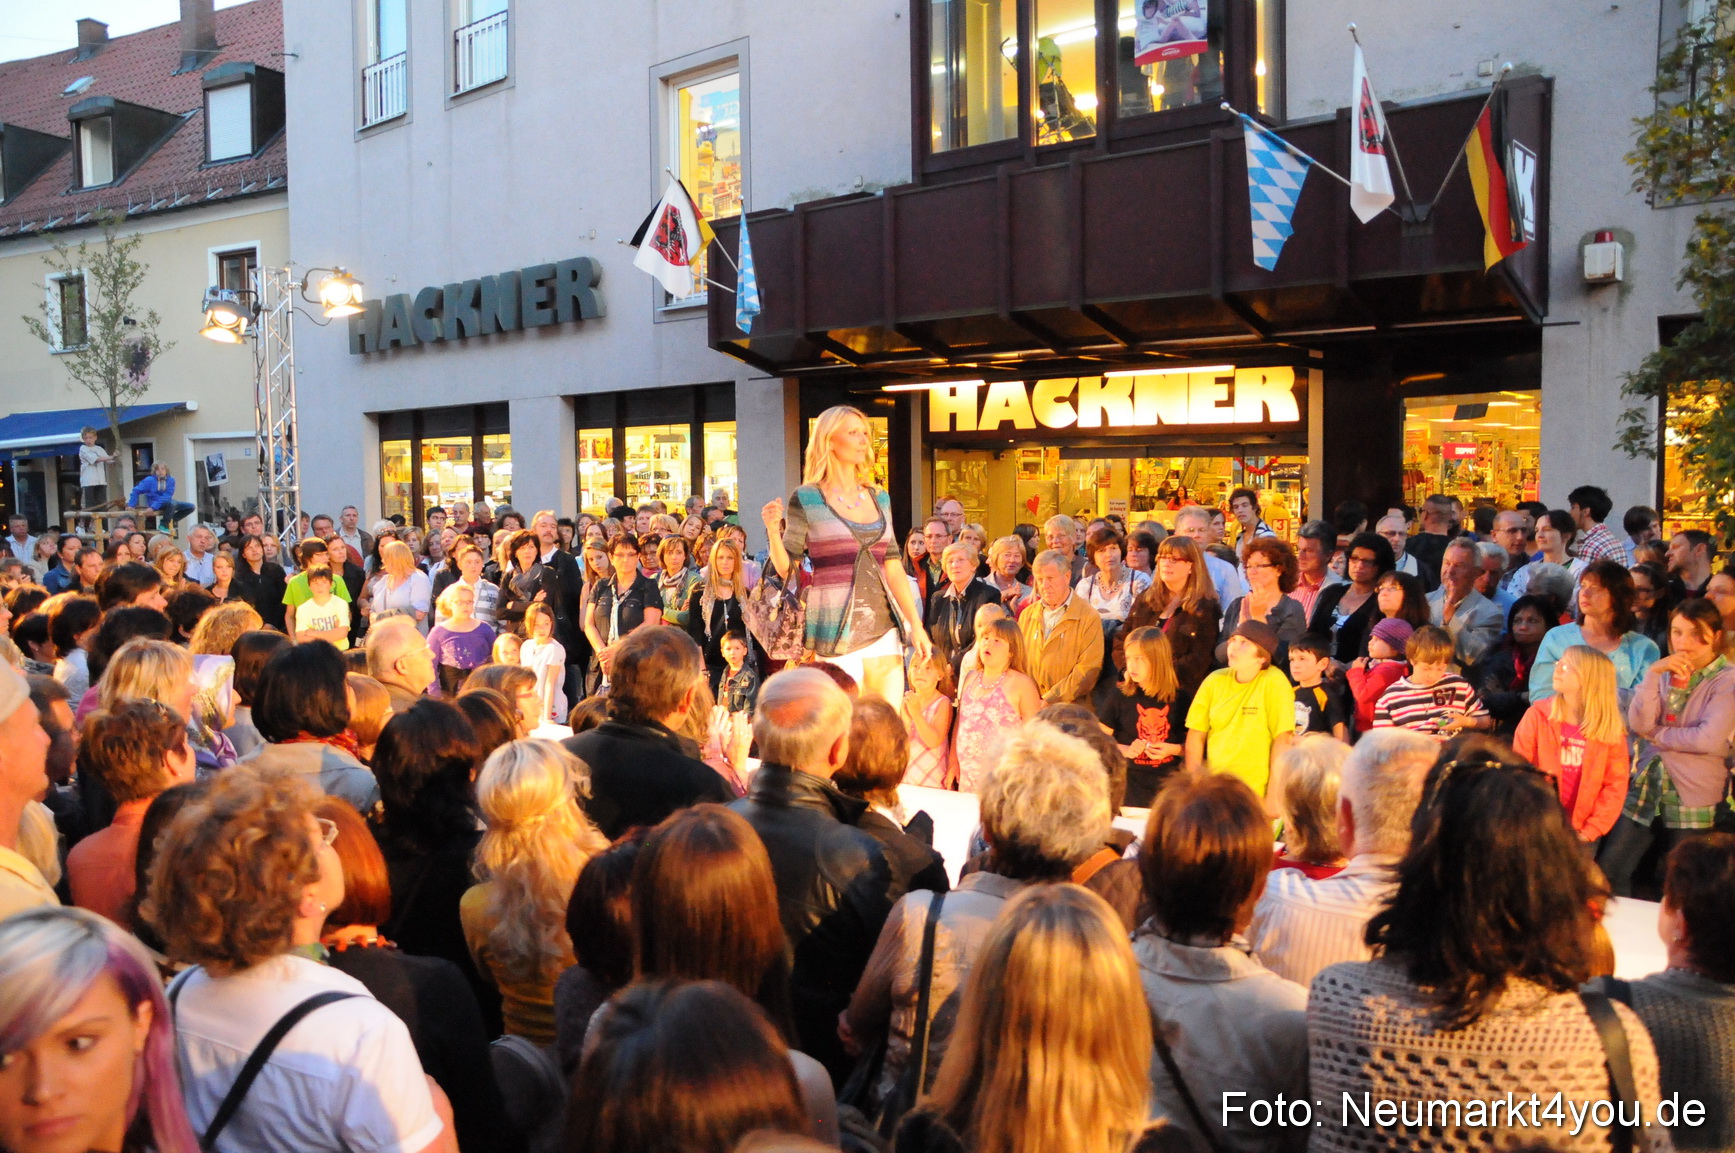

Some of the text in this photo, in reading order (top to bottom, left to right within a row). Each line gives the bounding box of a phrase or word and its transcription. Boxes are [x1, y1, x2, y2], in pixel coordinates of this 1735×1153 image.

[348, 256, 607, 355] HACKNER
[929, 366, 1300, 432] HACKNER
[1433, 687, 1456, 706] 67
